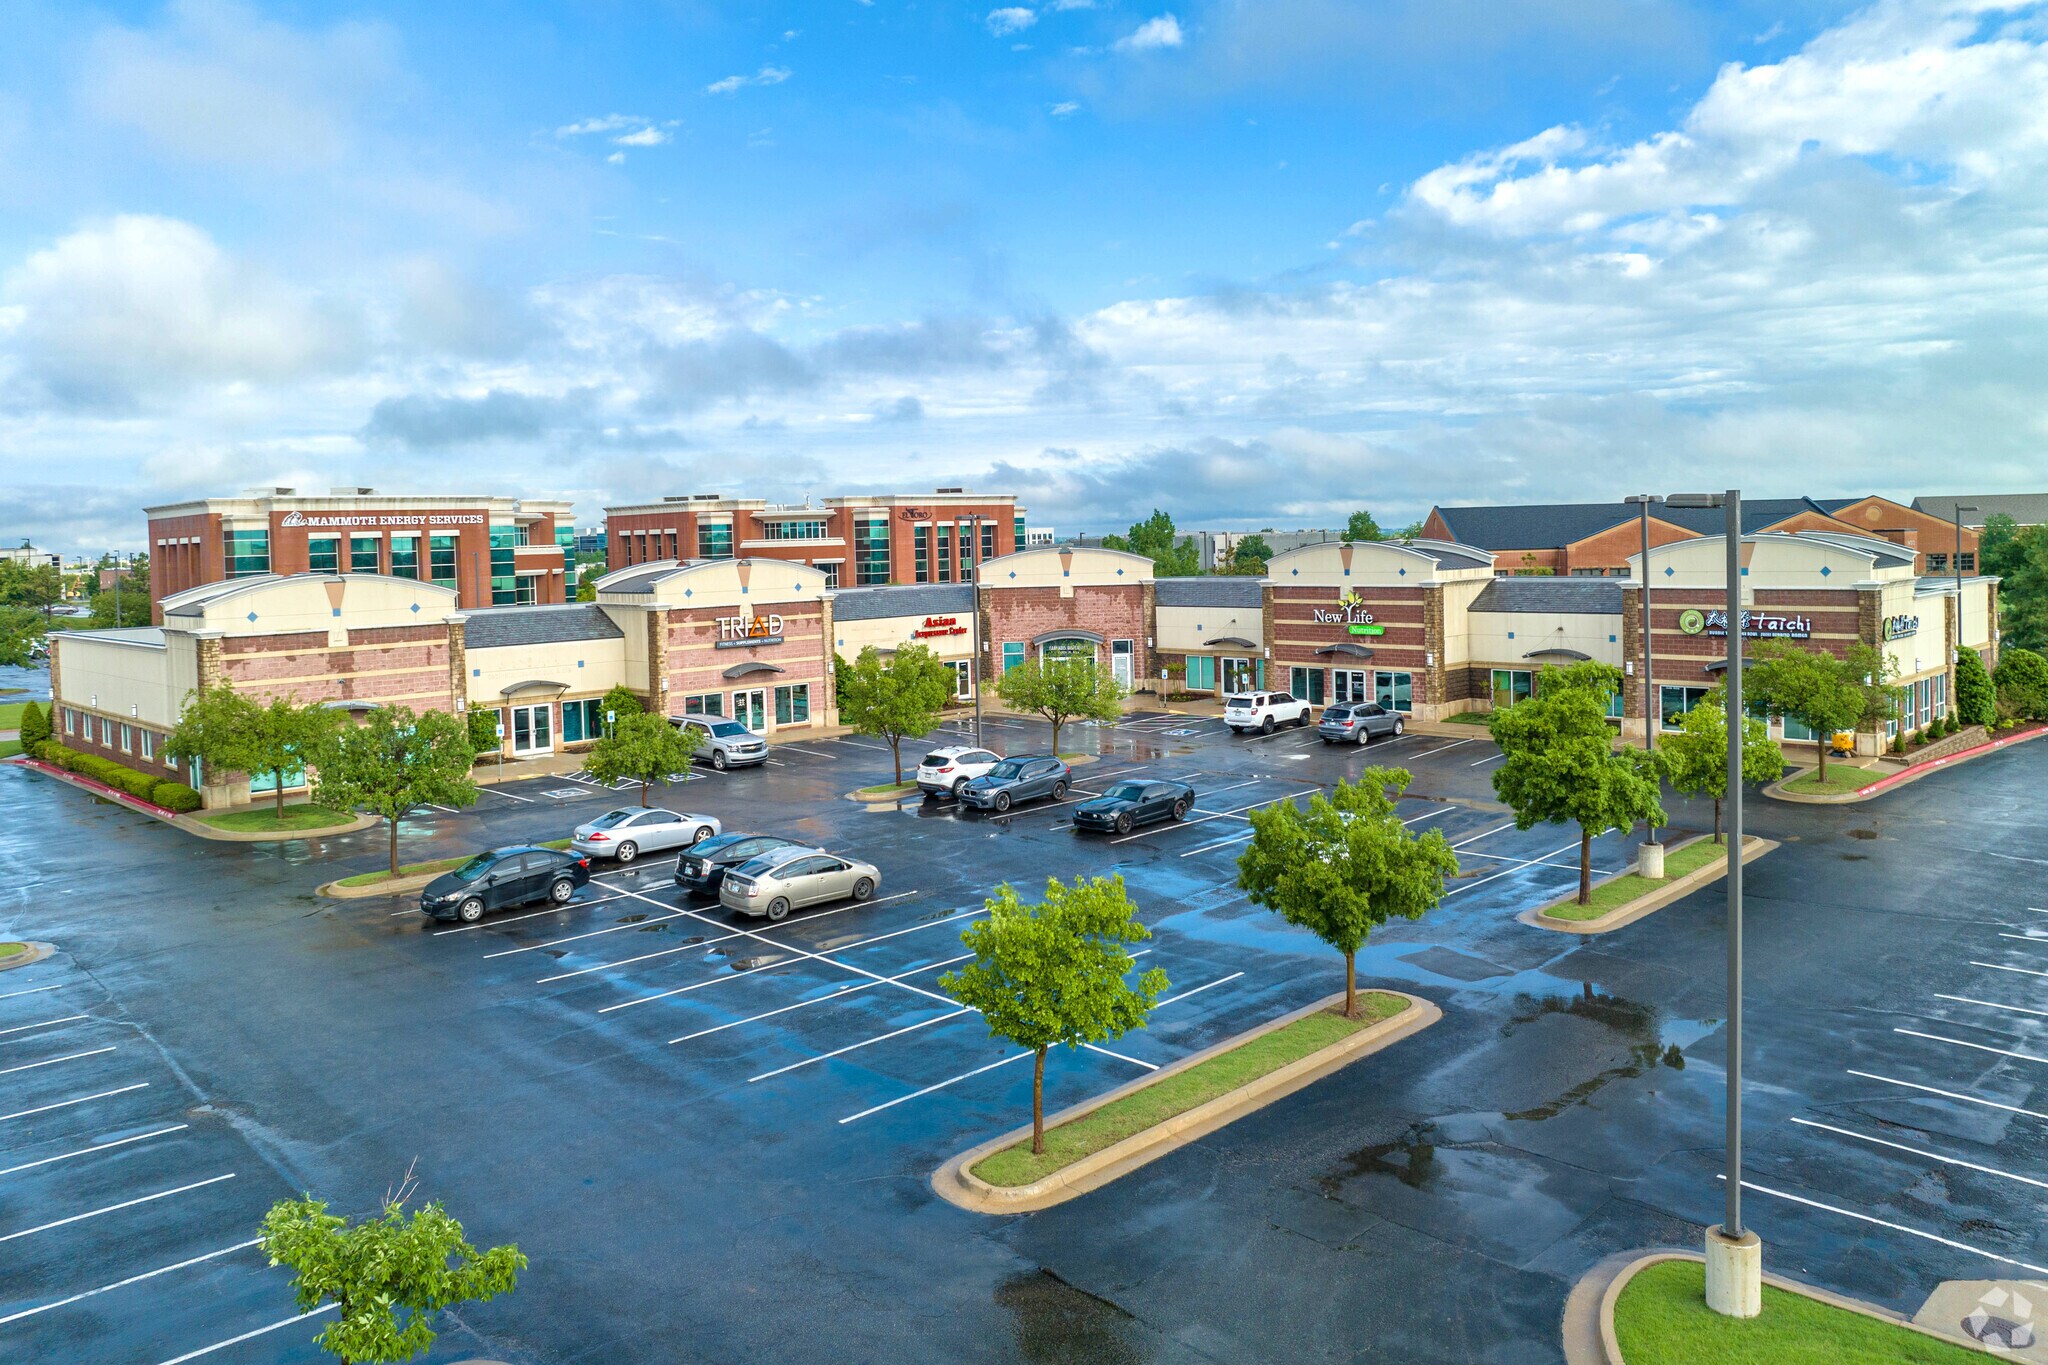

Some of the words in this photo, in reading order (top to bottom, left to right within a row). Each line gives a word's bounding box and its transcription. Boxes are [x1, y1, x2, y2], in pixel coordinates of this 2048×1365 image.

[307, 515, 377, 526] MAMMOTH
[379, 515, 427, 525] ENERGY
[429, 514, 484, 524] SERVICES
[1313, 609, 1343, 623] New
[1344, 602, 1373, 624] Life
[715, 614, 784, 639] TRIAD
[924, 616, 957, 627] Asian
[1751, 612, 1811, 631] Taichi
[1351, 626, 1381, 635] Nutrition
